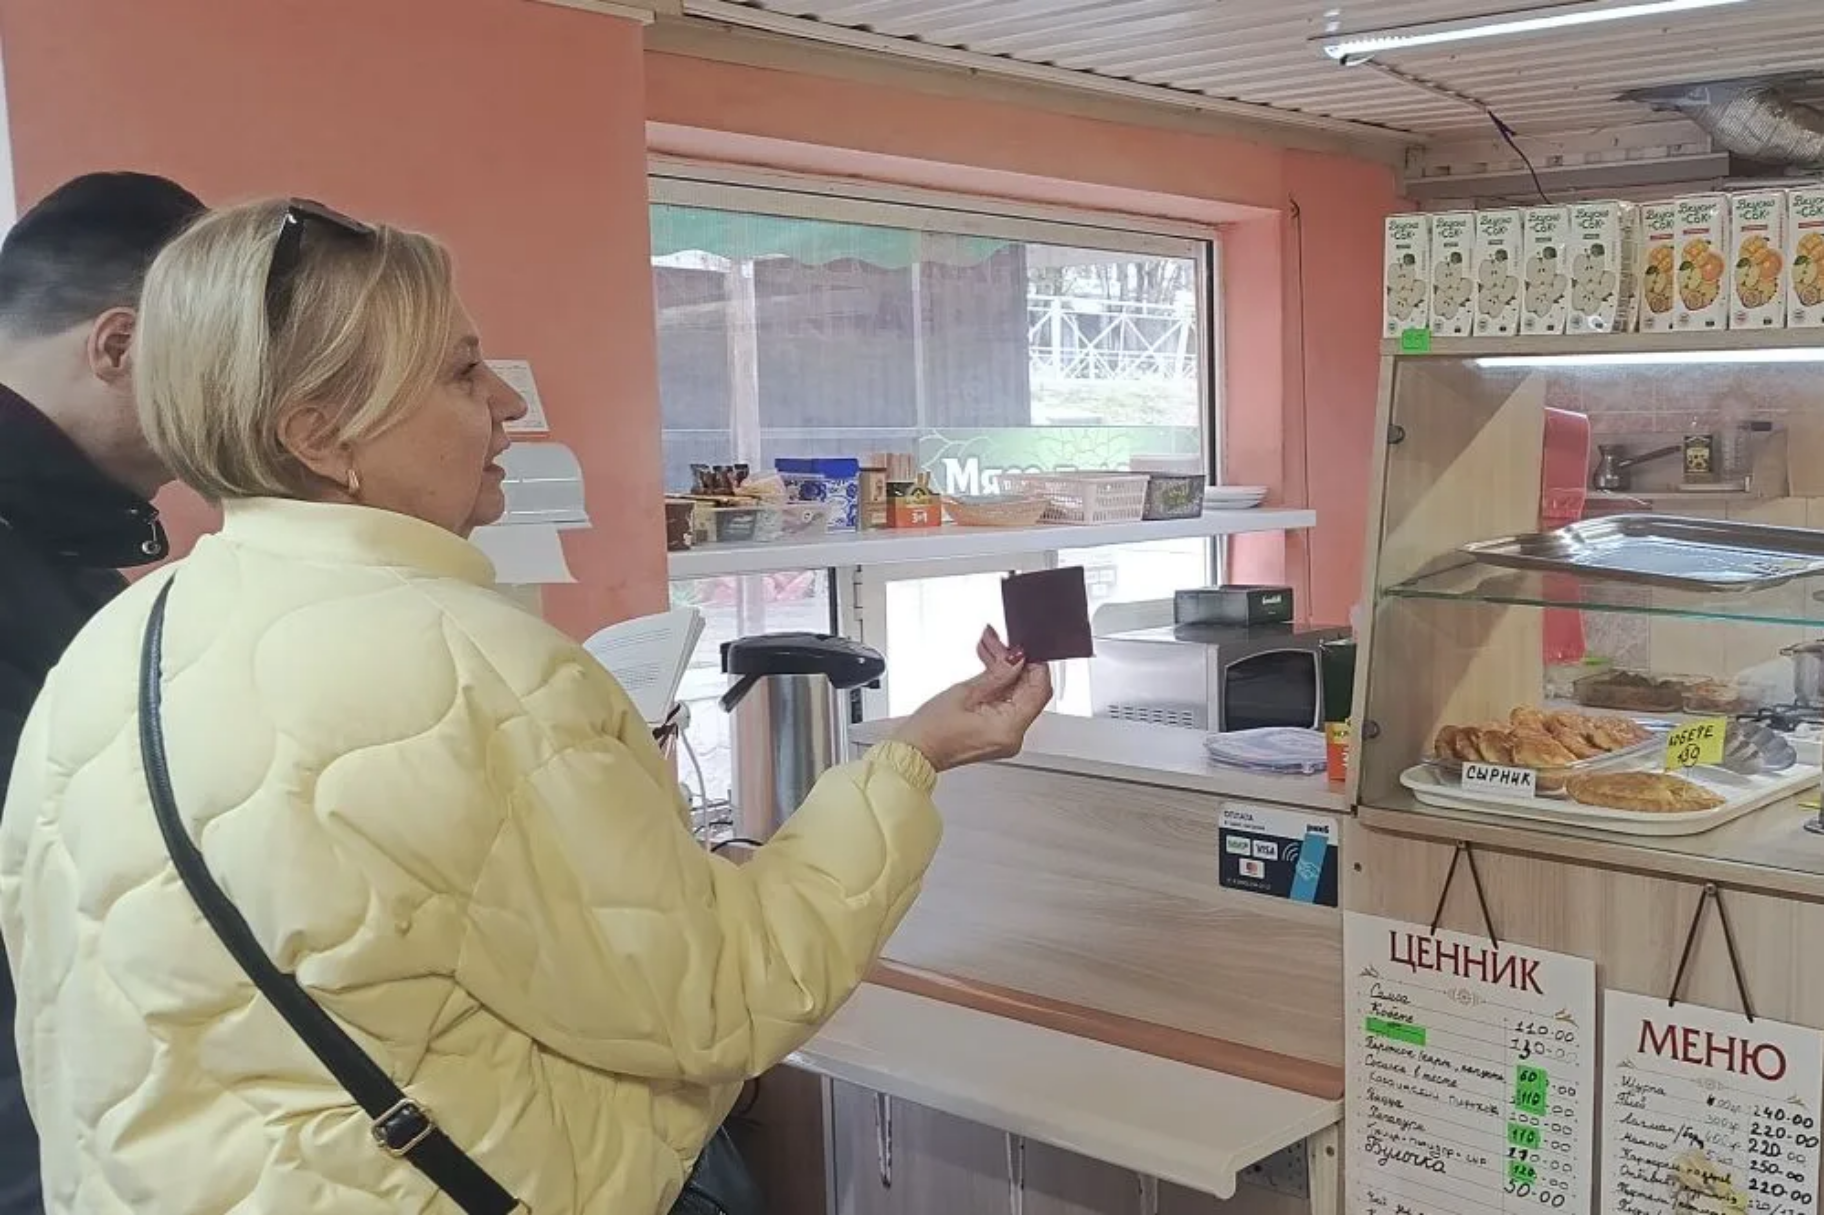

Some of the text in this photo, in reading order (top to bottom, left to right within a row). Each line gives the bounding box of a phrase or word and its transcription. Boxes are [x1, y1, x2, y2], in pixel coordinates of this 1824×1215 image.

[1466, 765, 1531, 787] СЫРНИК
[1256, 843, 1275, 856] VISA
[1389, 930, 1543, 995] ЦЕННИК
[1637, 1019, 1787, 1081] МЕНЮ
[1519, 1069, 1538, 1083] 60
[1365, 1135, 1446, 1174] Булочка
